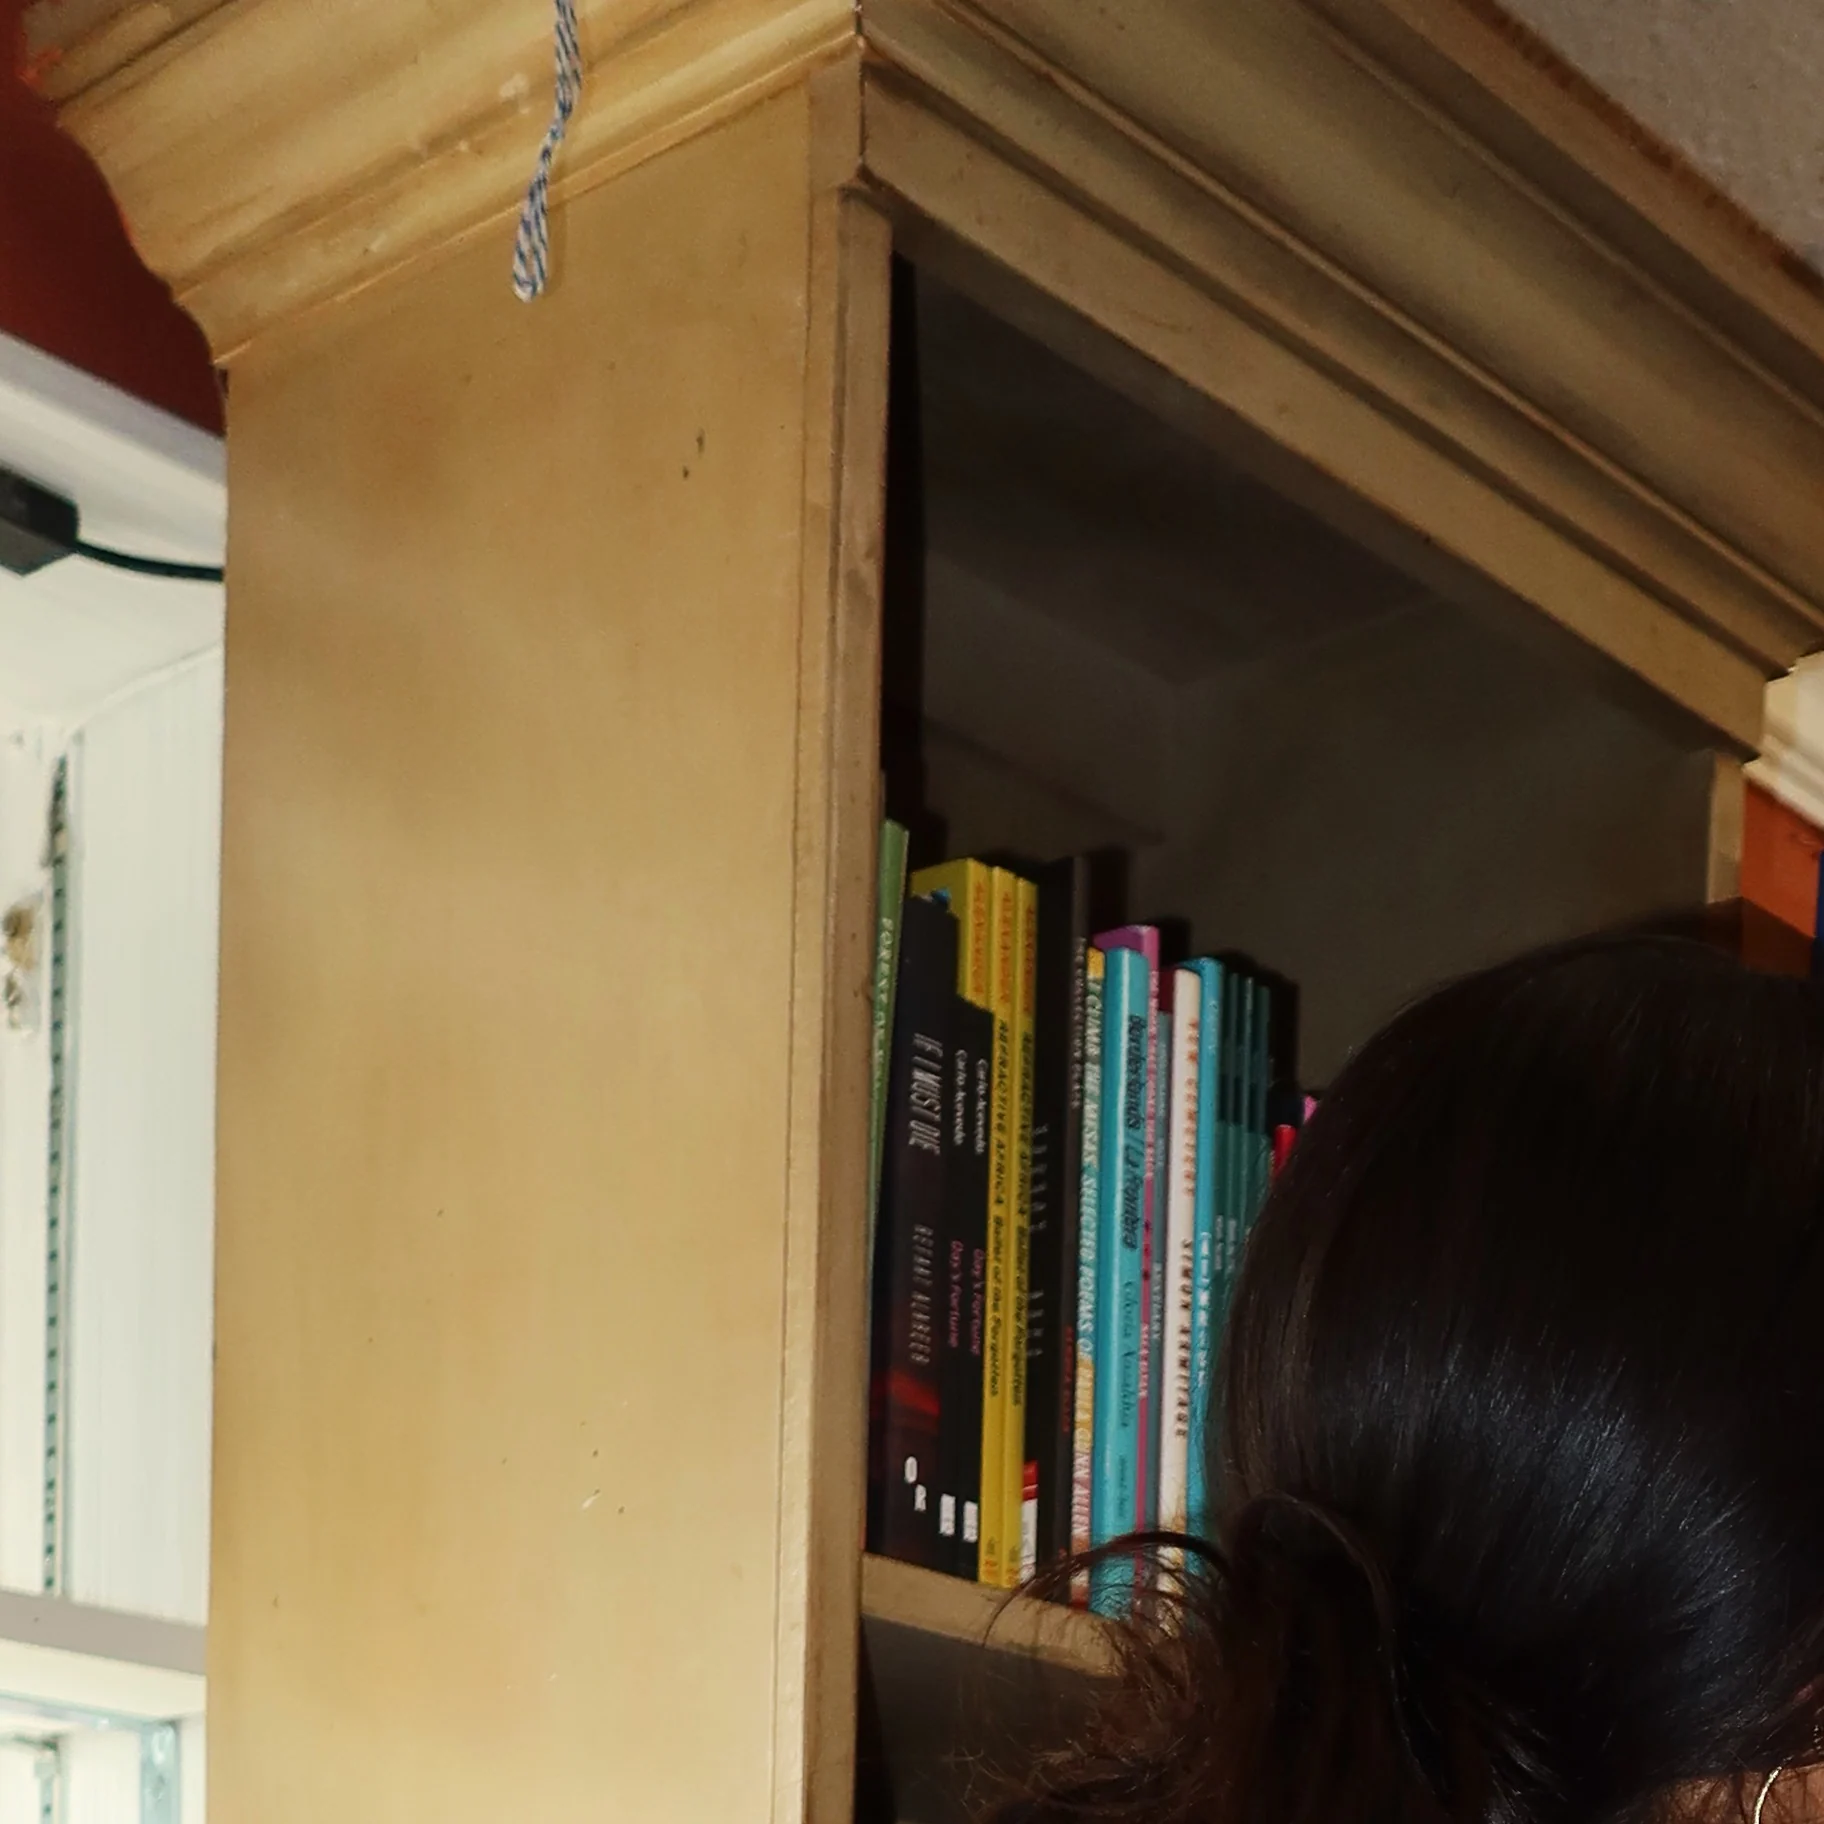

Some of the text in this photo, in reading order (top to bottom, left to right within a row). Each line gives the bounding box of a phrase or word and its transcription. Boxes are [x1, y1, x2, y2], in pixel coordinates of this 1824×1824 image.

[914, 1034, 944, 1058] IF
[1086, 995, 1102, 1057] CLIMB
[955, 1049, 969, 1083] Carlo
[975, 1058, 989, 1092] Carlo
[1085, 1061, 1101, 1100] THE
[1125, 1014, 1148, 1130] Borderlands
[910, 1069, 943, 1121] MUST
[907, 1120, 943, 1157] DIE
[1123, 1145, 1144, 1169] La
[1080, 1174, 1098, 1259] SELECTED
[1121, 1170, 1144, 1250] Frontera
[947, 1283, 962, 1348] Fortune
[969, 1292, 984, 1357] Fortune
[1079, 1265, 1096, 1332] POEMS
[1077, 1338, 1095, 1362] OF
[1175, 1237, 1194, 1438] SIMON ARMITAGE
[1075, 1364, 1094, 1422] PAULA
[1074, 1427, 1093, 1479] GUNN
[1072, 1484, 1092, 1537] ALLEN
